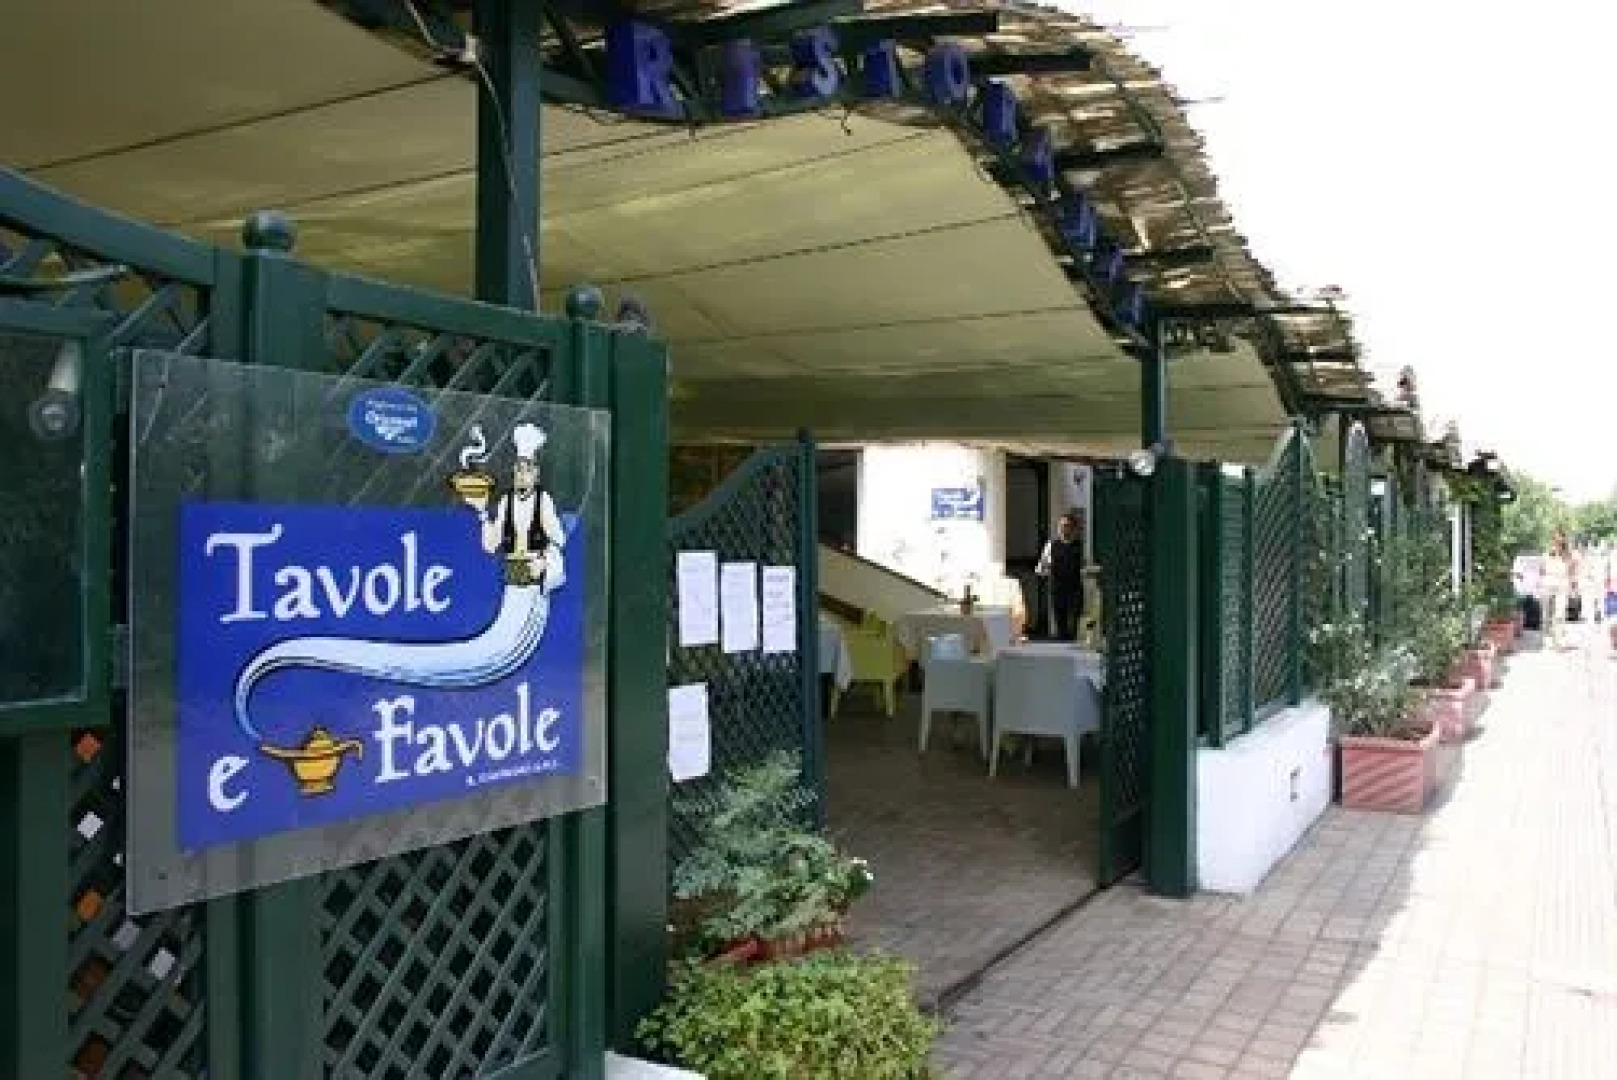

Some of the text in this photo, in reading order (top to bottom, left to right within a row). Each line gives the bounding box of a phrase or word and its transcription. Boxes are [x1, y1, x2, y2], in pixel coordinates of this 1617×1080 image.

[206, 523, 452, 623] Tavole
[207, 682, 560, 813] e Favole
